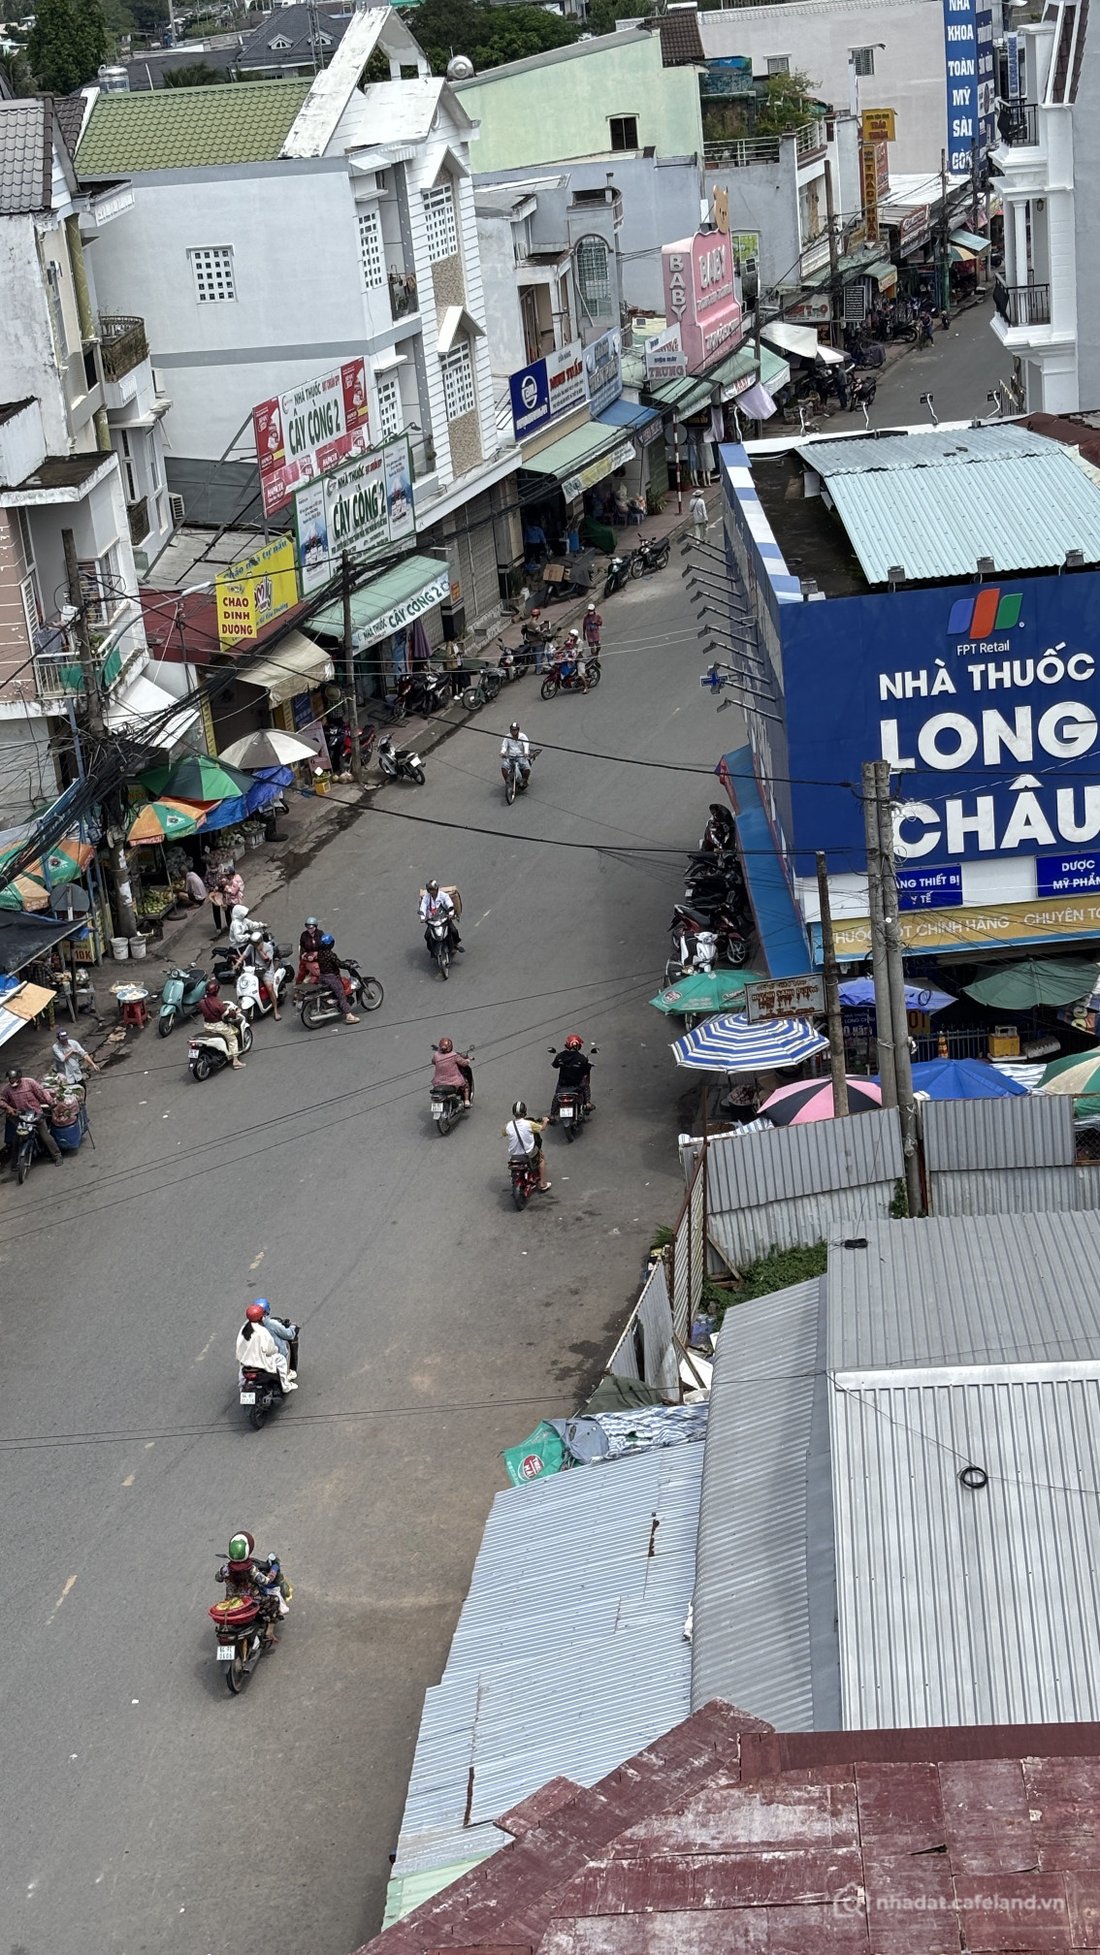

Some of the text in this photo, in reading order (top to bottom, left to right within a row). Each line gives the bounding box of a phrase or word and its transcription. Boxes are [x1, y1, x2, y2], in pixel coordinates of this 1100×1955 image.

[947, 24, 974, 41] KHOA
[948, 57, 975, 76] TOÀN
[952, 86, 971, 106] MỸ
[952, 116, 973, 137] SÀI
[698, 244, 726, 289] BABY
[669, 254, 687, 322] BABY
[305, 381, 322, 399] THUỐC
[288, 409, 306, 456] CÂY
[334, 398, 341, 432] 2
[338, 472, 348, 489] NHÀ
[333, 493, 352, 539] CÂY
[379, 481, 386, 516] 2
[222, 596, 249, 608] CHAO
[388, 607, 408, 628] CÂY
[431, 586, 442, 598] 2
[223, 611, 250, 620] DINH
[221, 624, 253, 635] DUONG
[957, 640, 1010, 656] FPT Retail
[879, 641, 1095, 700] NHÀ THUỐC
[880, 701, 1098, 771] LONG
[891, 773, 1100, 859] CHÂU
[1061, 859, 1096, 872] DƯỢC
[919, 873, 947, 887] THIẾT
[949, 875, 960, 886] BỊ
[1053, 877, 1070, 890] MỸ
[920, 891, 934, 904] TẾ
[916, 917, 963, 937] CHÍNH
[965, 913, 1010, 932] HÃNG
[1024, 907, 1084, 925] CHUYÊN
[75, 950, 92, 960] 10K
